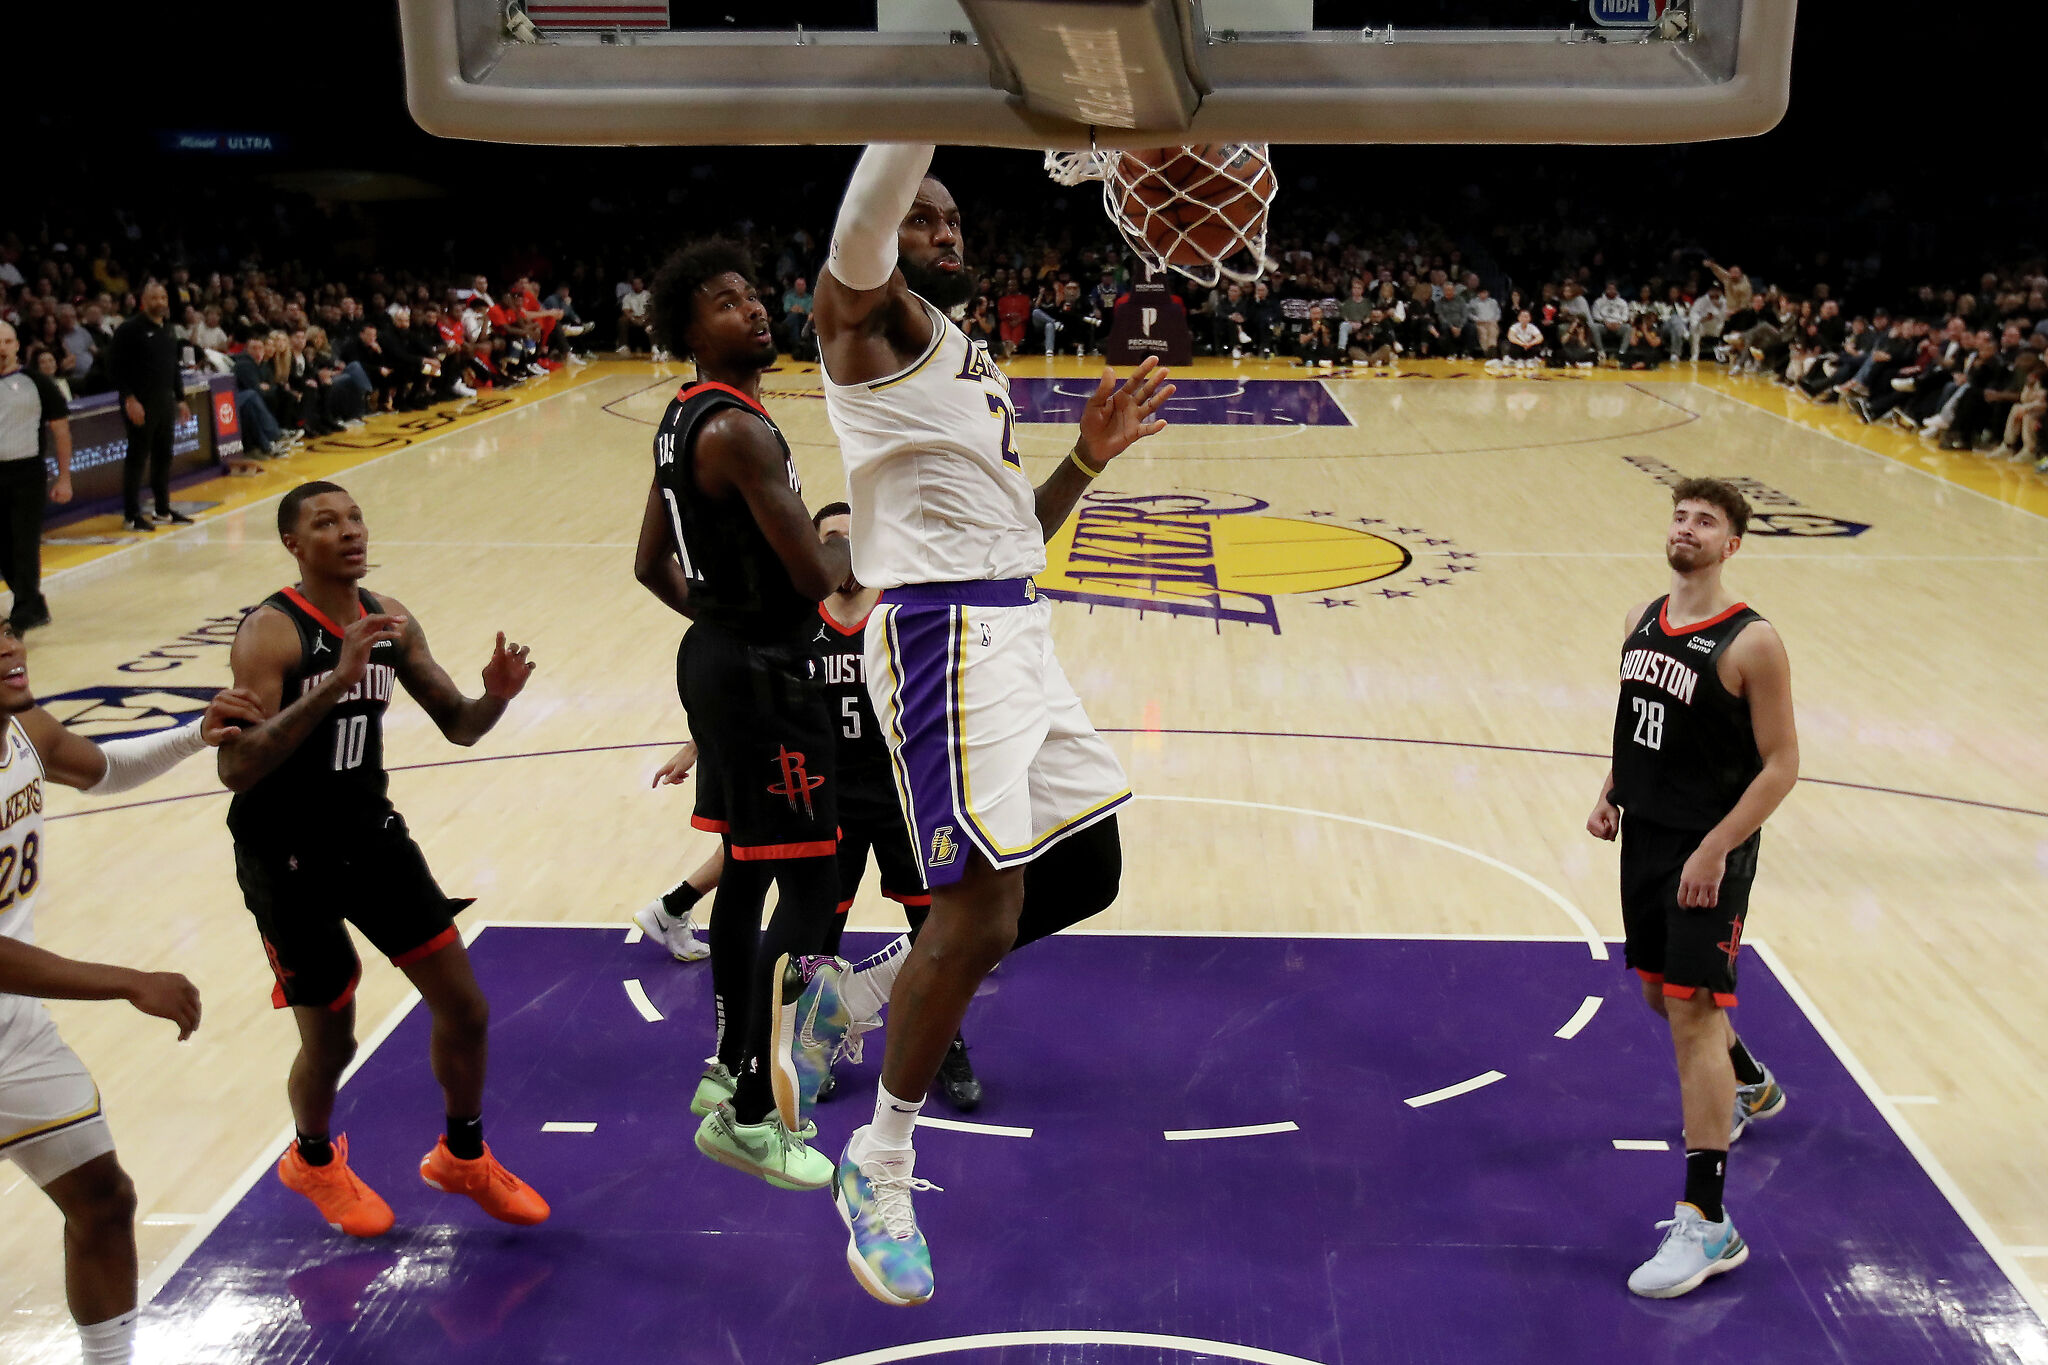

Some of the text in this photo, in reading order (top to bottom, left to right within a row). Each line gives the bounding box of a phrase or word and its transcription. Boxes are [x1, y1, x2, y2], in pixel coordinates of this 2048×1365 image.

[228, 137, 272, 150] ULTRA
[1127, 339, 1168, 348] PECHANGA
[1686, 640, 1711, 654] karma
[1691, 635, 1716, 649] credit
[1620, 649, 1698, 705] HOUSTON
[841, 696, 861, 739] 5
[1632, 696, 1665, 751] 28
[334, 714, 368, 771] 10
[0, 831, 40, 914] 28
